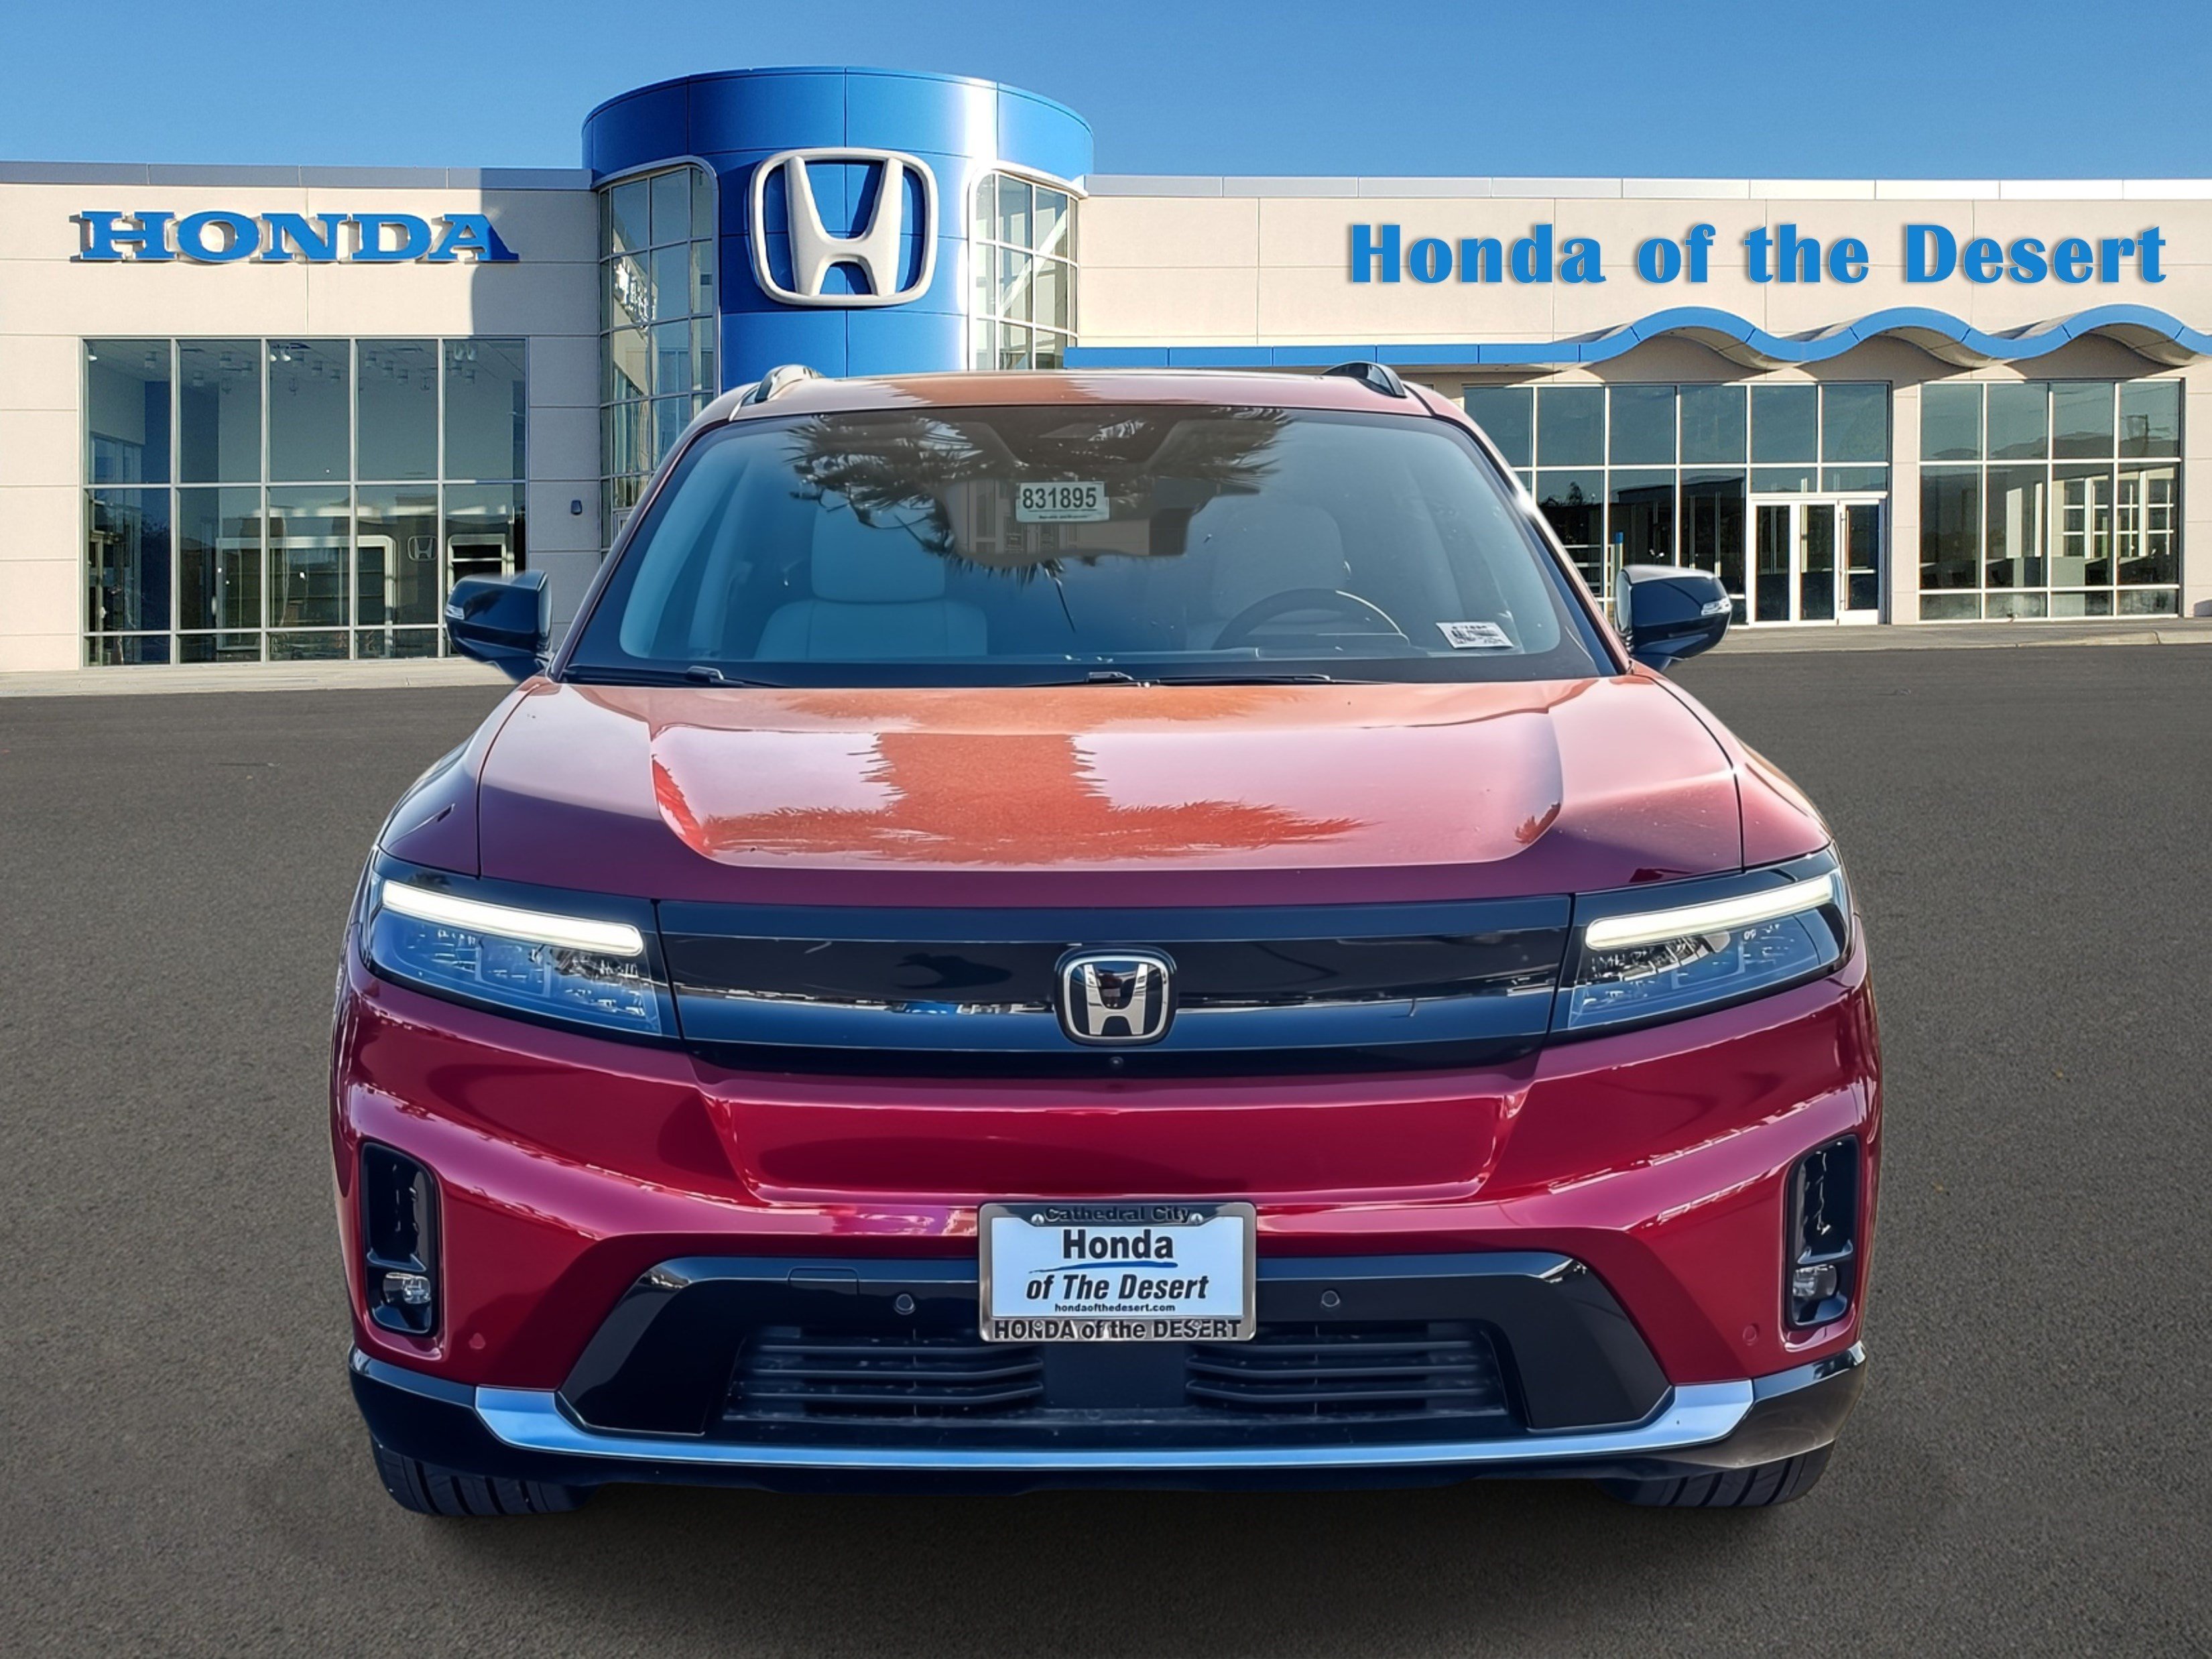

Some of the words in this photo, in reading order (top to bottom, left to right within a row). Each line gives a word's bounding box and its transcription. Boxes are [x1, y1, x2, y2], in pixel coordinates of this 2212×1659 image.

[80, 210, 519, 262] HONDA
[1351, 223, 1607, 284] Honda
[1638, 223, 1717, 284] of
[1743, 223, 1869, 284] the
[1906, 225, 2166, 284] Desert
[1022, 487, 1097, 509] 831895
[1044, 1206, 1144, 1223] Cathedral
[1150, 1206, 1190, 1224] City
[1063, 1229, 1174, 1259] Honda
[1026, 1275, 1055, 1299] of
[1063, 1275, 1109, 1299] The
[1118, 1275, 1209, 1299] Desert
[1054, 1303, 1176, 1312] hondaofthedesert.com
[993, 1319, 1074, 1339] HONDA
[1081, 1319, 1107, 1339] of
[1110, 1319, 1146, 1339] the
[1153, 1319, 1241, 1339] DESERT
